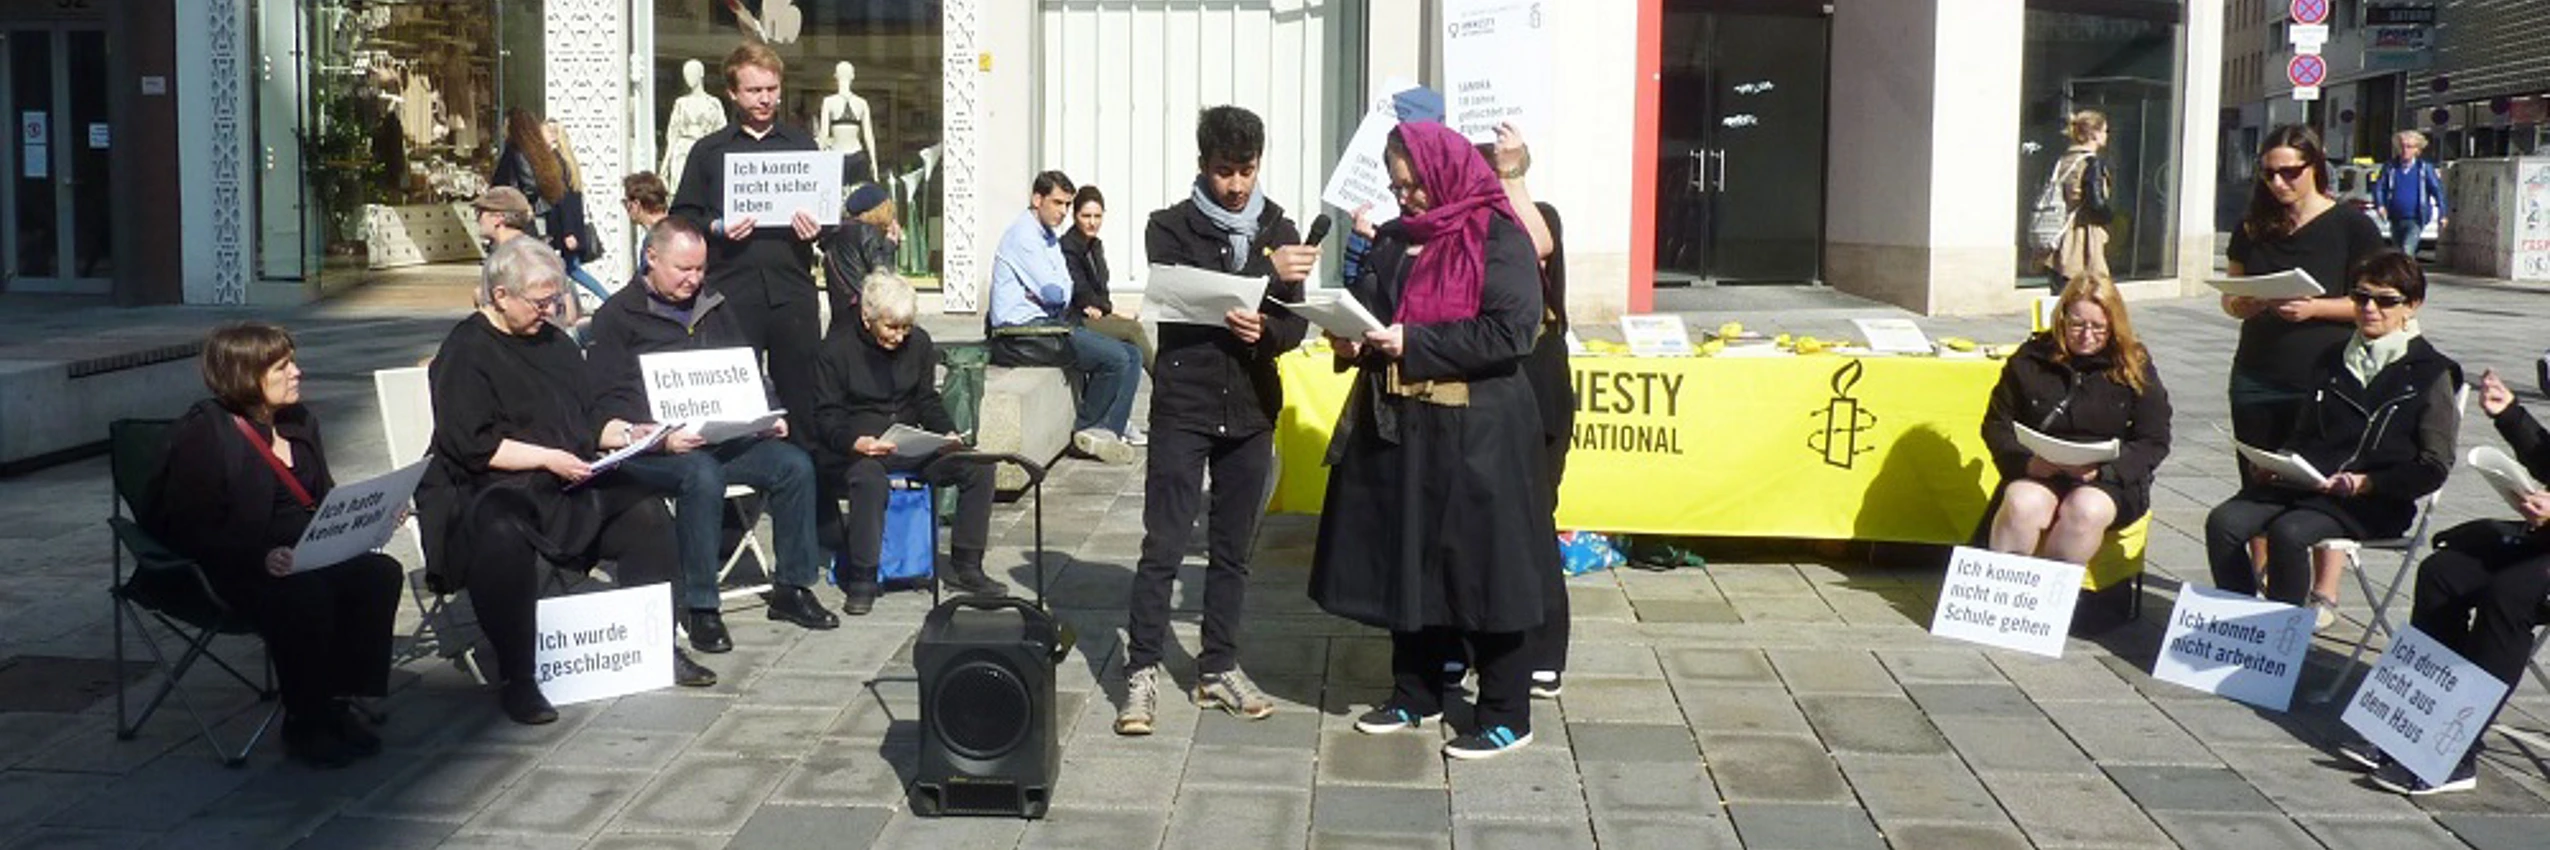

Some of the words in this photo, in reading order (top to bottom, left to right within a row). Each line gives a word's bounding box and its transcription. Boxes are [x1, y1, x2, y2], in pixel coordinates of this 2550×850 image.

[734, 162, 757, 176] Ich
[762, 161, 810, 174] konnte
[734, 181, 769, 194] nicht
[775, 179, 818, 192] sicher
[734, 198, 773, 212] leben
[654, 369, 684, 389] Ich
[688, 365, 750, 386] musste
[660, 398, 722, 419] fliehen
[319, 501, 345, 520] Ich
[346, 492, 384, 513] hatte
[305, 522, 349, 542] keine
[351, 507, 386, 530] Wahl
[1957, 558, 1982, 577] Ich
[1986, 563, 2041, 587] konnte
[1950, 582, 1990, 603] nicht
[1994, 588, 2008, 605] in
[2013, 591, 2038, 611] die
[1944, 603, 1996, 626] Schule
[1999, 616, 2051, 636] gehen
[2179, 609, 2205, 629] Ich
[2208, 615, 2266, 644] konnte
[539, 630, 567, 651] Ich
[573, 623, 628, 646] wurde
[540, 650, 642, 684] geschlagen
[2171, 636, 2212, 659] nicht
[2215, 647, 2286, 677] arbeiten
[2391, 636, 2416, 666] Ich
[2414, 653, 2458, 692] durfte
[2374, 666, 2413, 698] nicht
[2409, 690, 2436, 715] aus
[2358, 689, 2390, 720] dem
[2388, 707, 2424, 743] Haus
